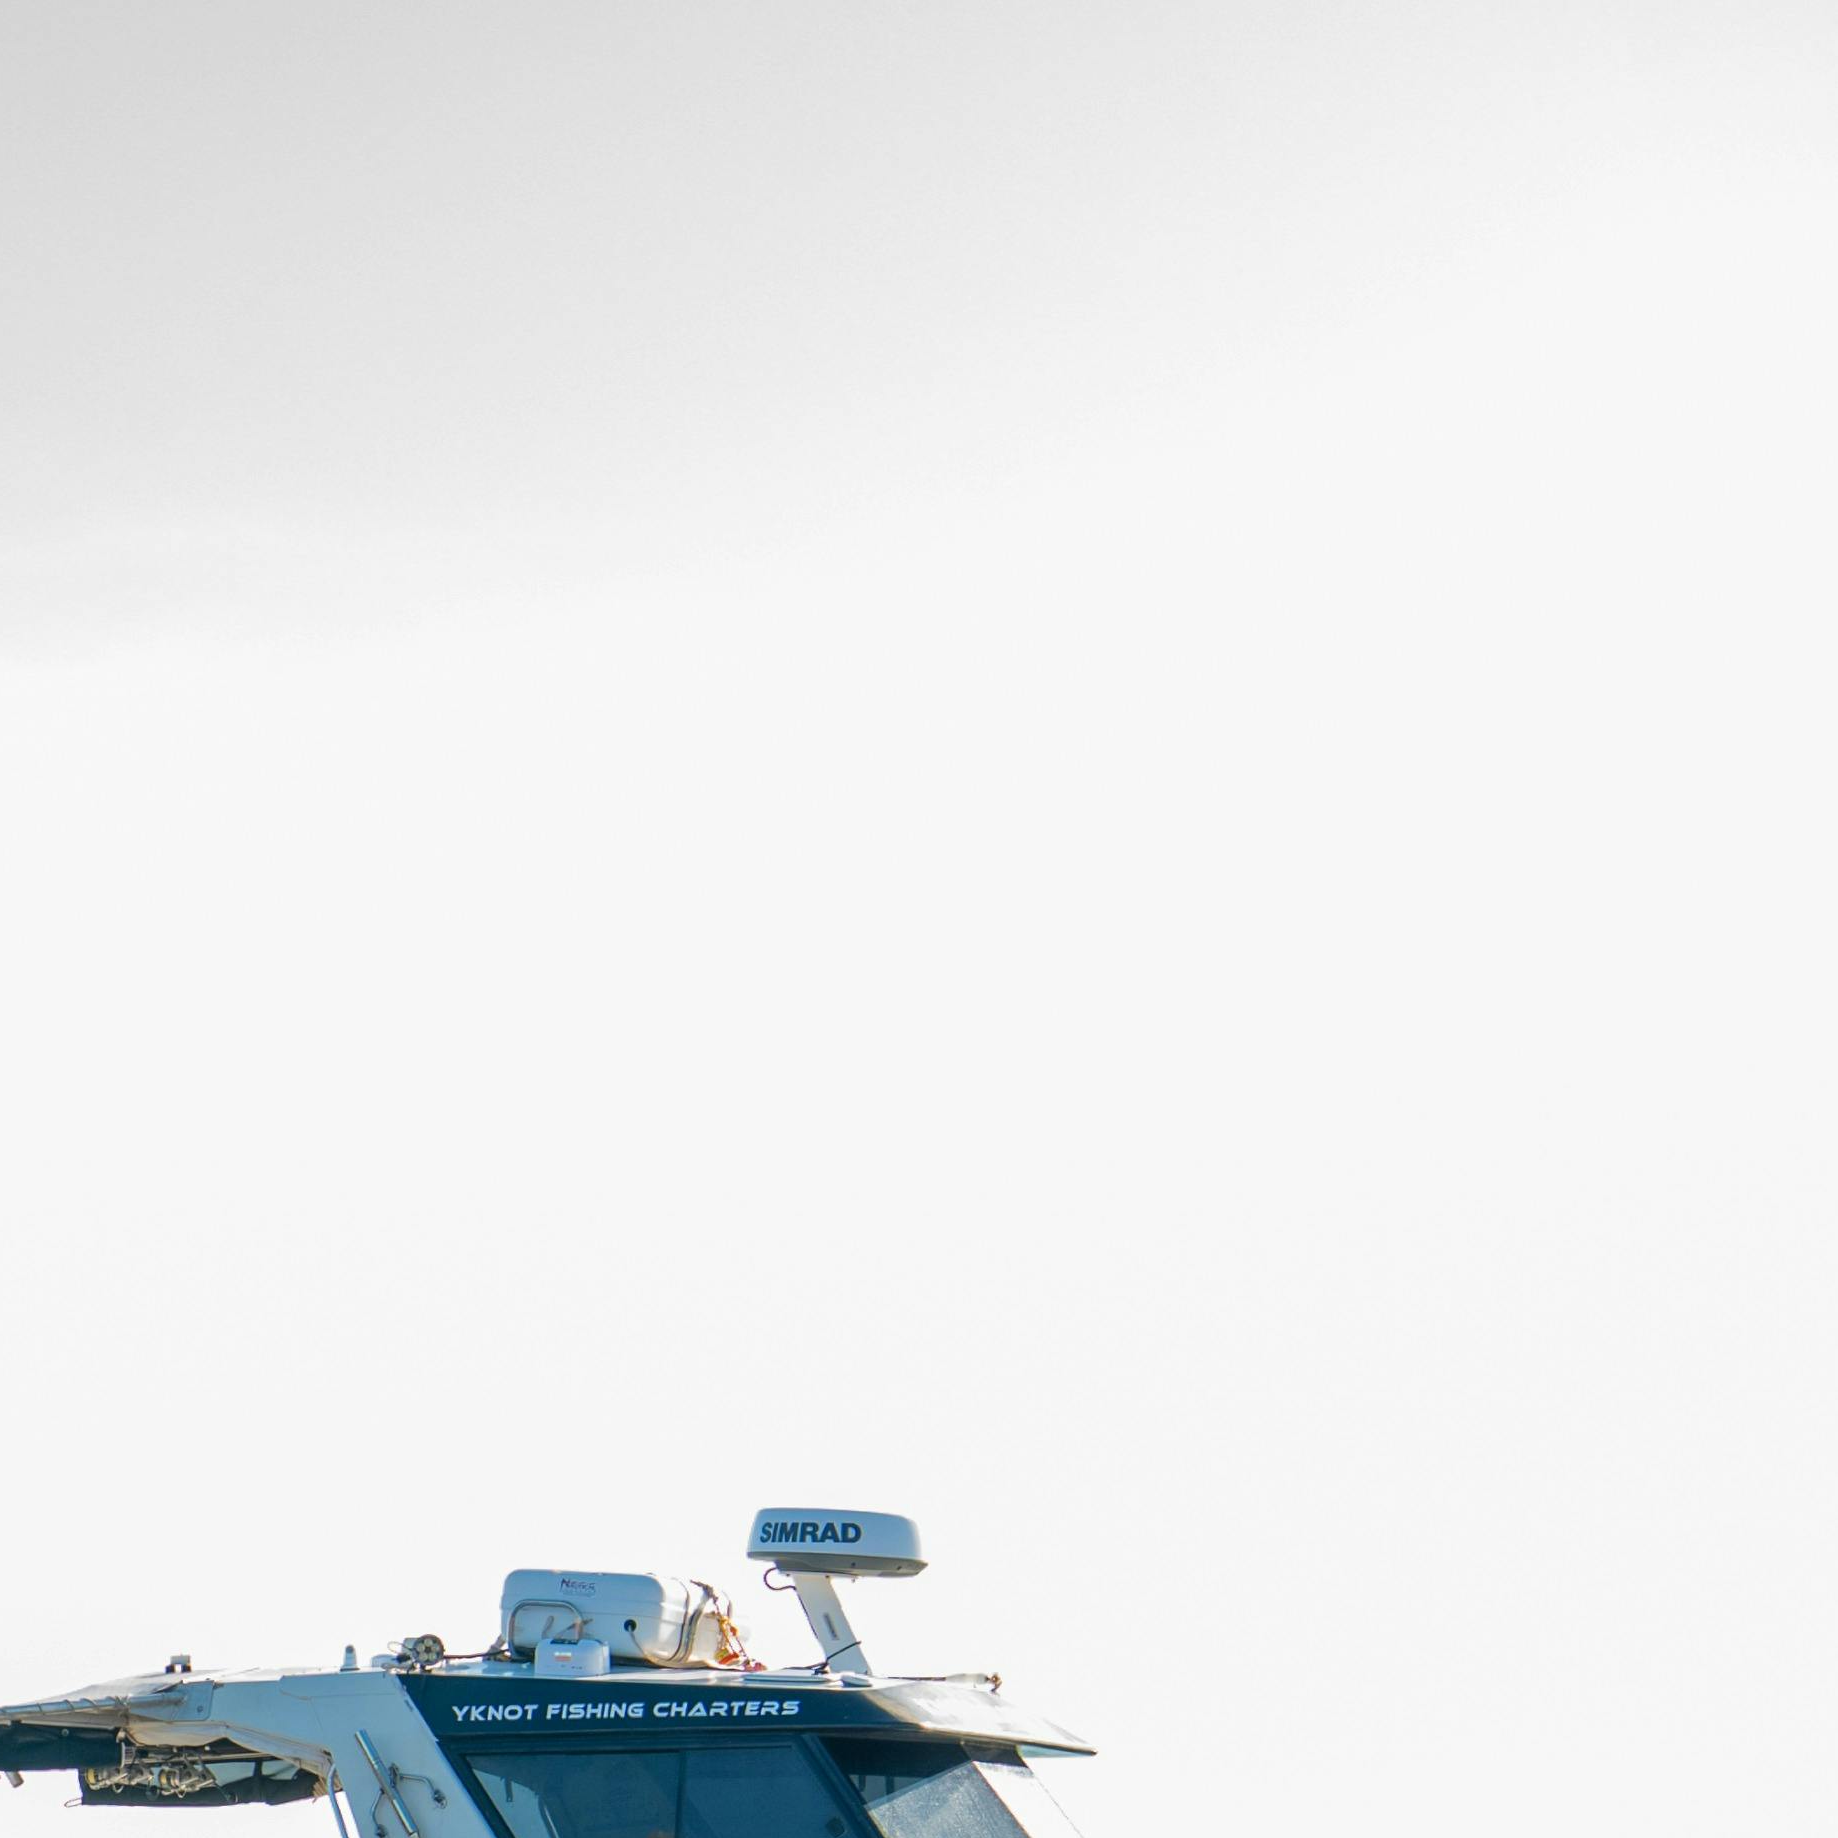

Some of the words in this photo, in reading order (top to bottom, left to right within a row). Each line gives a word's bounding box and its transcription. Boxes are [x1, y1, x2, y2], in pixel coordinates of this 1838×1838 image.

[759, 1521, 862, 1544] SIMRAD
[451, 1704, 539, 1722] YKNOT
[545, 1702, 645, 1720] FISHING
[652, 1700, 800, 1718] CHARTERS
